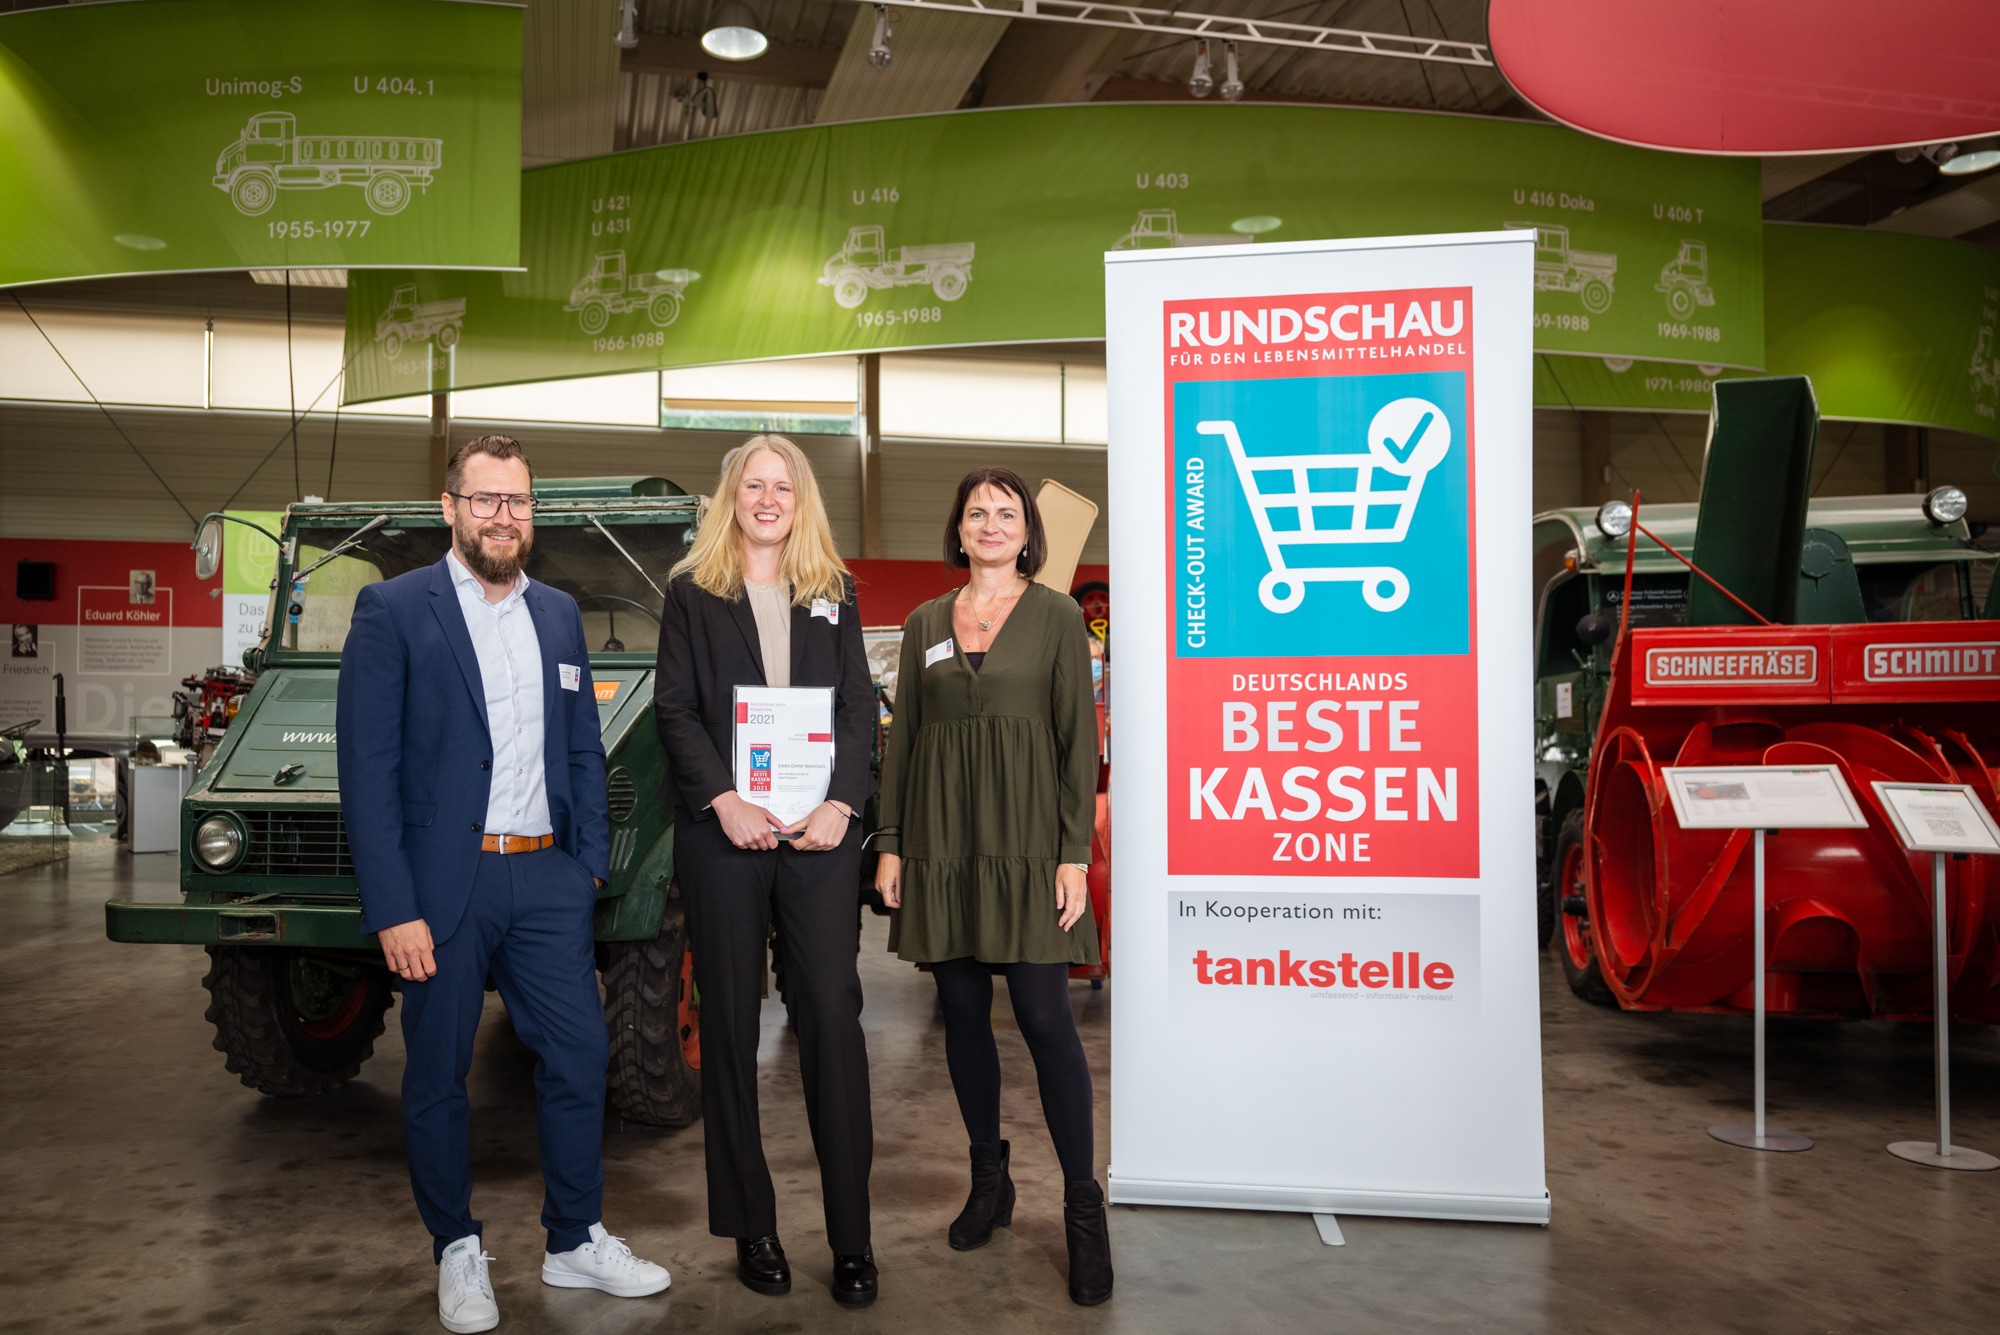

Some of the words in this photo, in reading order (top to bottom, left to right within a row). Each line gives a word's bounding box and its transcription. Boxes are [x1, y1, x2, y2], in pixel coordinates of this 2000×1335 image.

[206, 76, 303, 99] Unimog-S
[353, 76, 369, 94] U
[376, 77, 435, 97] 404.1
[1136, 172, 1150, 189] U
[1154, 172, 1190, 190] 403
[592, 198, 603, 214] U
[606, 195, 631, 212] 421
[852, 189, 866, 206] U
[870, 187, 900, 204] 416
[1513, 189, 1525, 205] U
[1529, 191, 1556, 208] 416
[1559, 193, 1596, 213] Doka
[1652, 203, 1664, 220] U
[1666, 206, 1693, 223] 406
[1696, 208, 1705, 224] T
[266, 220, 372, 239] 1955-1977
[591, 221, 603, 237] U
[606, 217, 631, 235] 431
[856, 306, 942, 329] 1965-1988
[1169, 300, 1465, 348] RUNDSCHAU
[1533, 312, 1590, 332] 69-1988
[592, 331, 665, 353] 1966-1988
[1657, 322, 1721, 343] 1969-1988
[1170, 353, 1204, 367] FÜR
[1211, 351, 1246, 365] DEN
[1253, 342, 1467, 364] LEBENSMITTELHANDEL
[1186, 456, 1206, 531] AWARD
[1186, 534, 1207, 649] CHECK-OUT
[84, 608, 123, 621] Eduard
[125, 609, 161, 622] Köhler
[239, 602, 265, 617] Das
[238, 623, 254, 635] zu
[3, 663, 50, 676] Friedrich
[1656, 651, 1807, 677] SCHNEEFRÄSE
[1874, 648, 1997, 675] SCHMIDT
[1232, 672, 1409, 692] DEUTSCHLANDS
[750, 714, 775, 725] 2021
[1222, 699, 1422, 753] BESTE
[1189, 766, 1459, 822] KASSEN
[1272, 832, 1372, 863] ZONE
[1178, 900, 1197, 918] In
[1205, 900, 1334, 923] Kooperation
[1343, 904, 1382, 920] mit:
[1192, 949, 1456, 991] tankstelle
[1310, 990, 1360, 1000] umfassend
[1365, 991, 1411, 1001] informativ
[1416, 993, 1454, 1002] relevant
